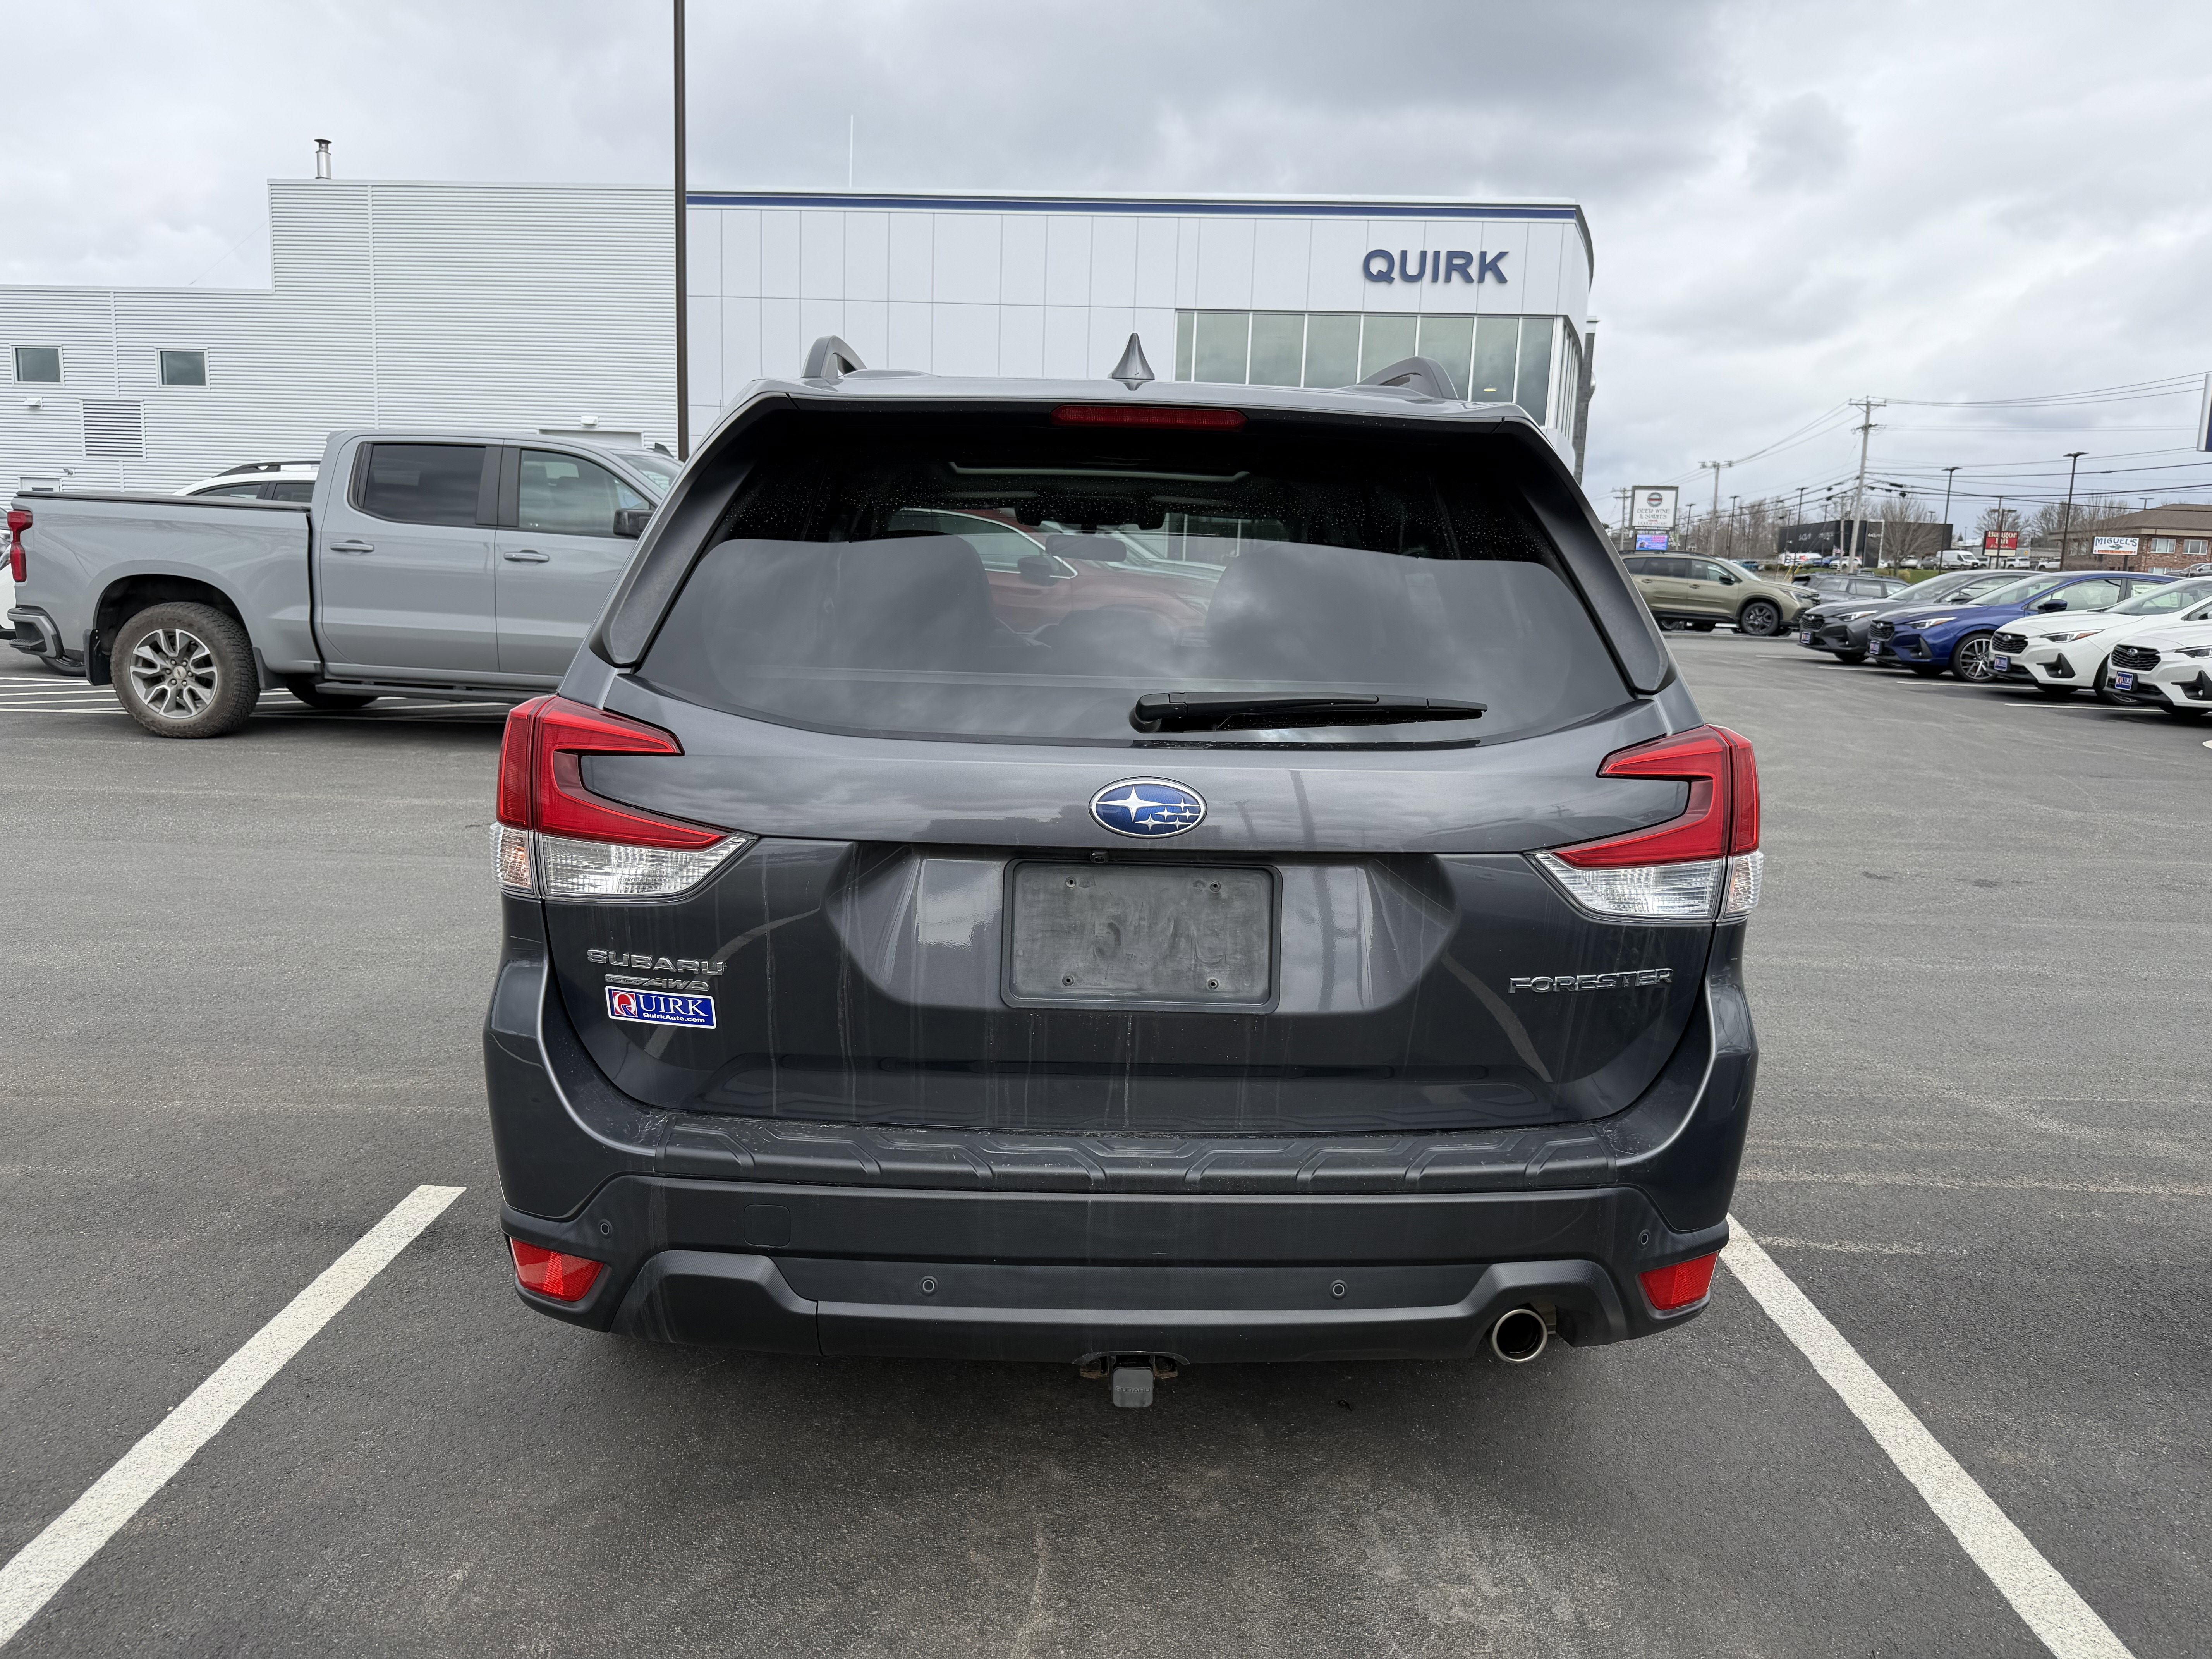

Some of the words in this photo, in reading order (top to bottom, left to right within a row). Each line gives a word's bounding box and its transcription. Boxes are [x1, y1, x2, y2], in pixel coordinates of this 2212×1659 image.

[1362, 249, 1509, 284] QUIRK
[2095, 538, 2137, 547] MIGUEL'S
[587, 949, 726, 976] SUBARU
[643, 978, 709, 991] AWD
[1508, 968, 1673, 993] FORESTER
[614, 993, 709, 1017] QUIRK
[642, 1012, 705, 1023] QuirkAuto.com
